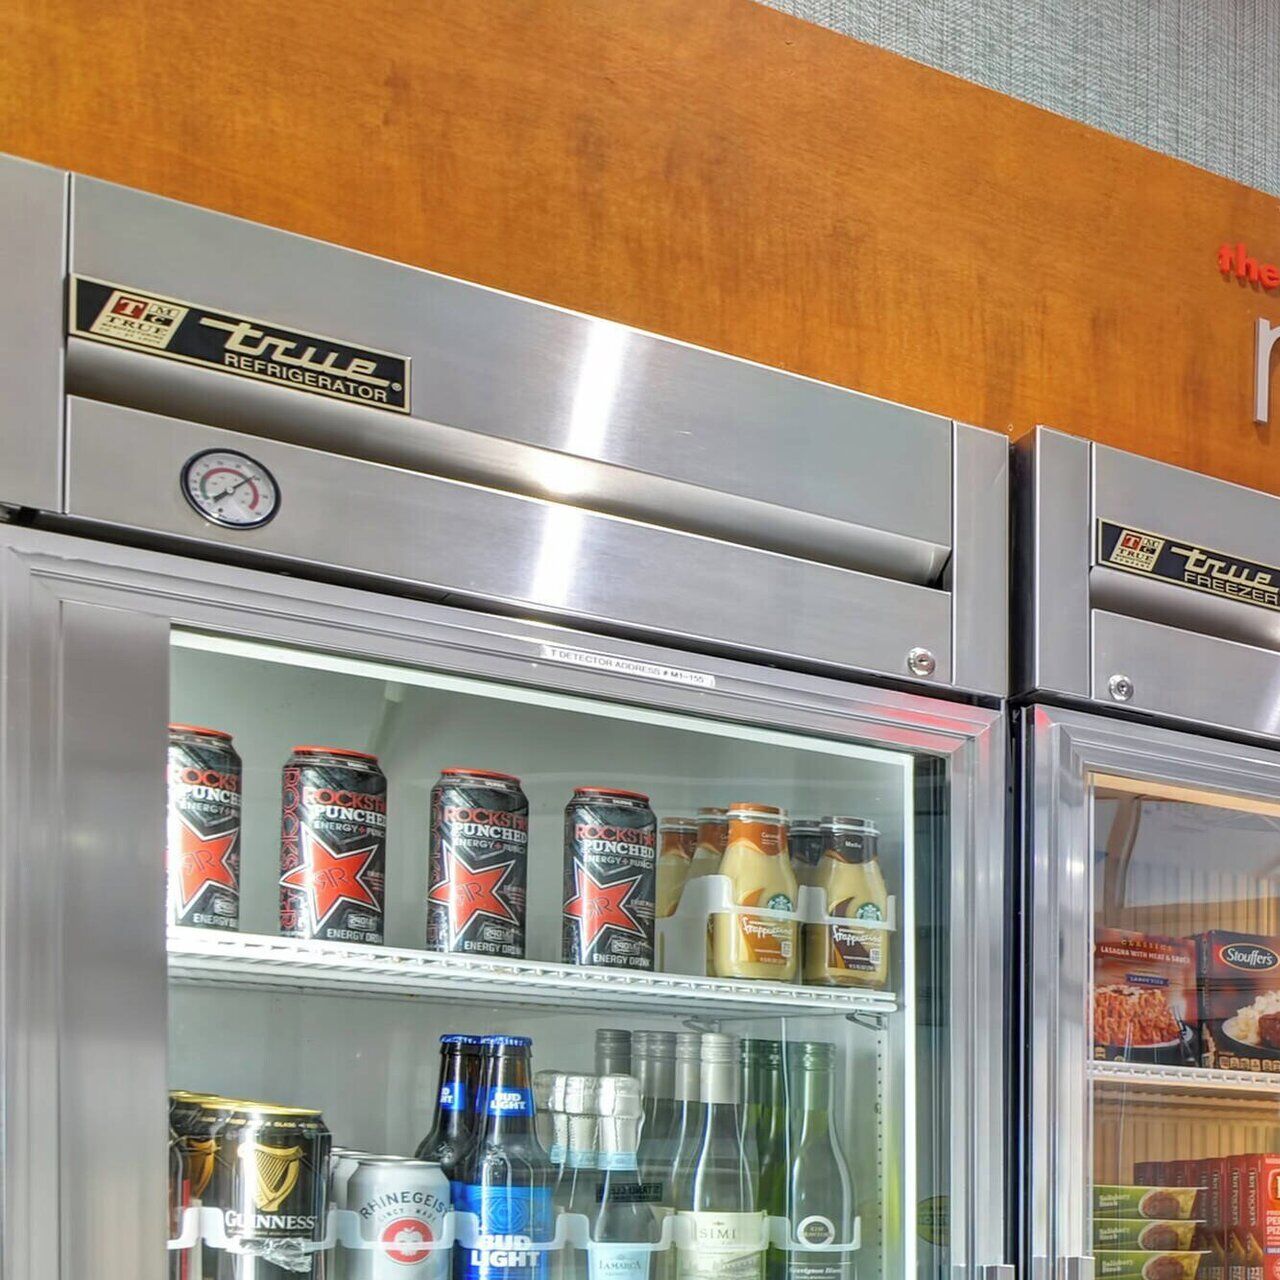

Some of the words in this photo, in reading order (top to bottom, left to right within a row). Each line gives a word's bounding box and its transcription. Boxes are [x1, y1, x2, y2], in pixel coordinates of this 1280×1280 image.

[1217, 244, 1280, 289] the
[200, 316, 391, 388] true
[224, 352, 387, 402] REFRIGERATOR
[1170, 546, 1279, 593] true
[1184, 571, 1278, 605] FREEZER
[559, 650, 613, 667] DETECTOR
[615, 660, 661, 676] ADDRESS
[451, 823, 528, 844] PUNCHED
[582, 839, 655, 860] PUNCHED
[326, 928, 364, 941] ENERGY
[464, 940, 501, 952] ENERGY
[593, 953, 629, 965] ENERGY
[1226, 947, 1273, 966] Stouffer's
[489, 1100, 526, 1110] LIGHT
[494, 1092, 521, 1102] BUD
[699, 1229, 737, 1239] SIMI
[470, 1250, 541, 1267] LIGHT
